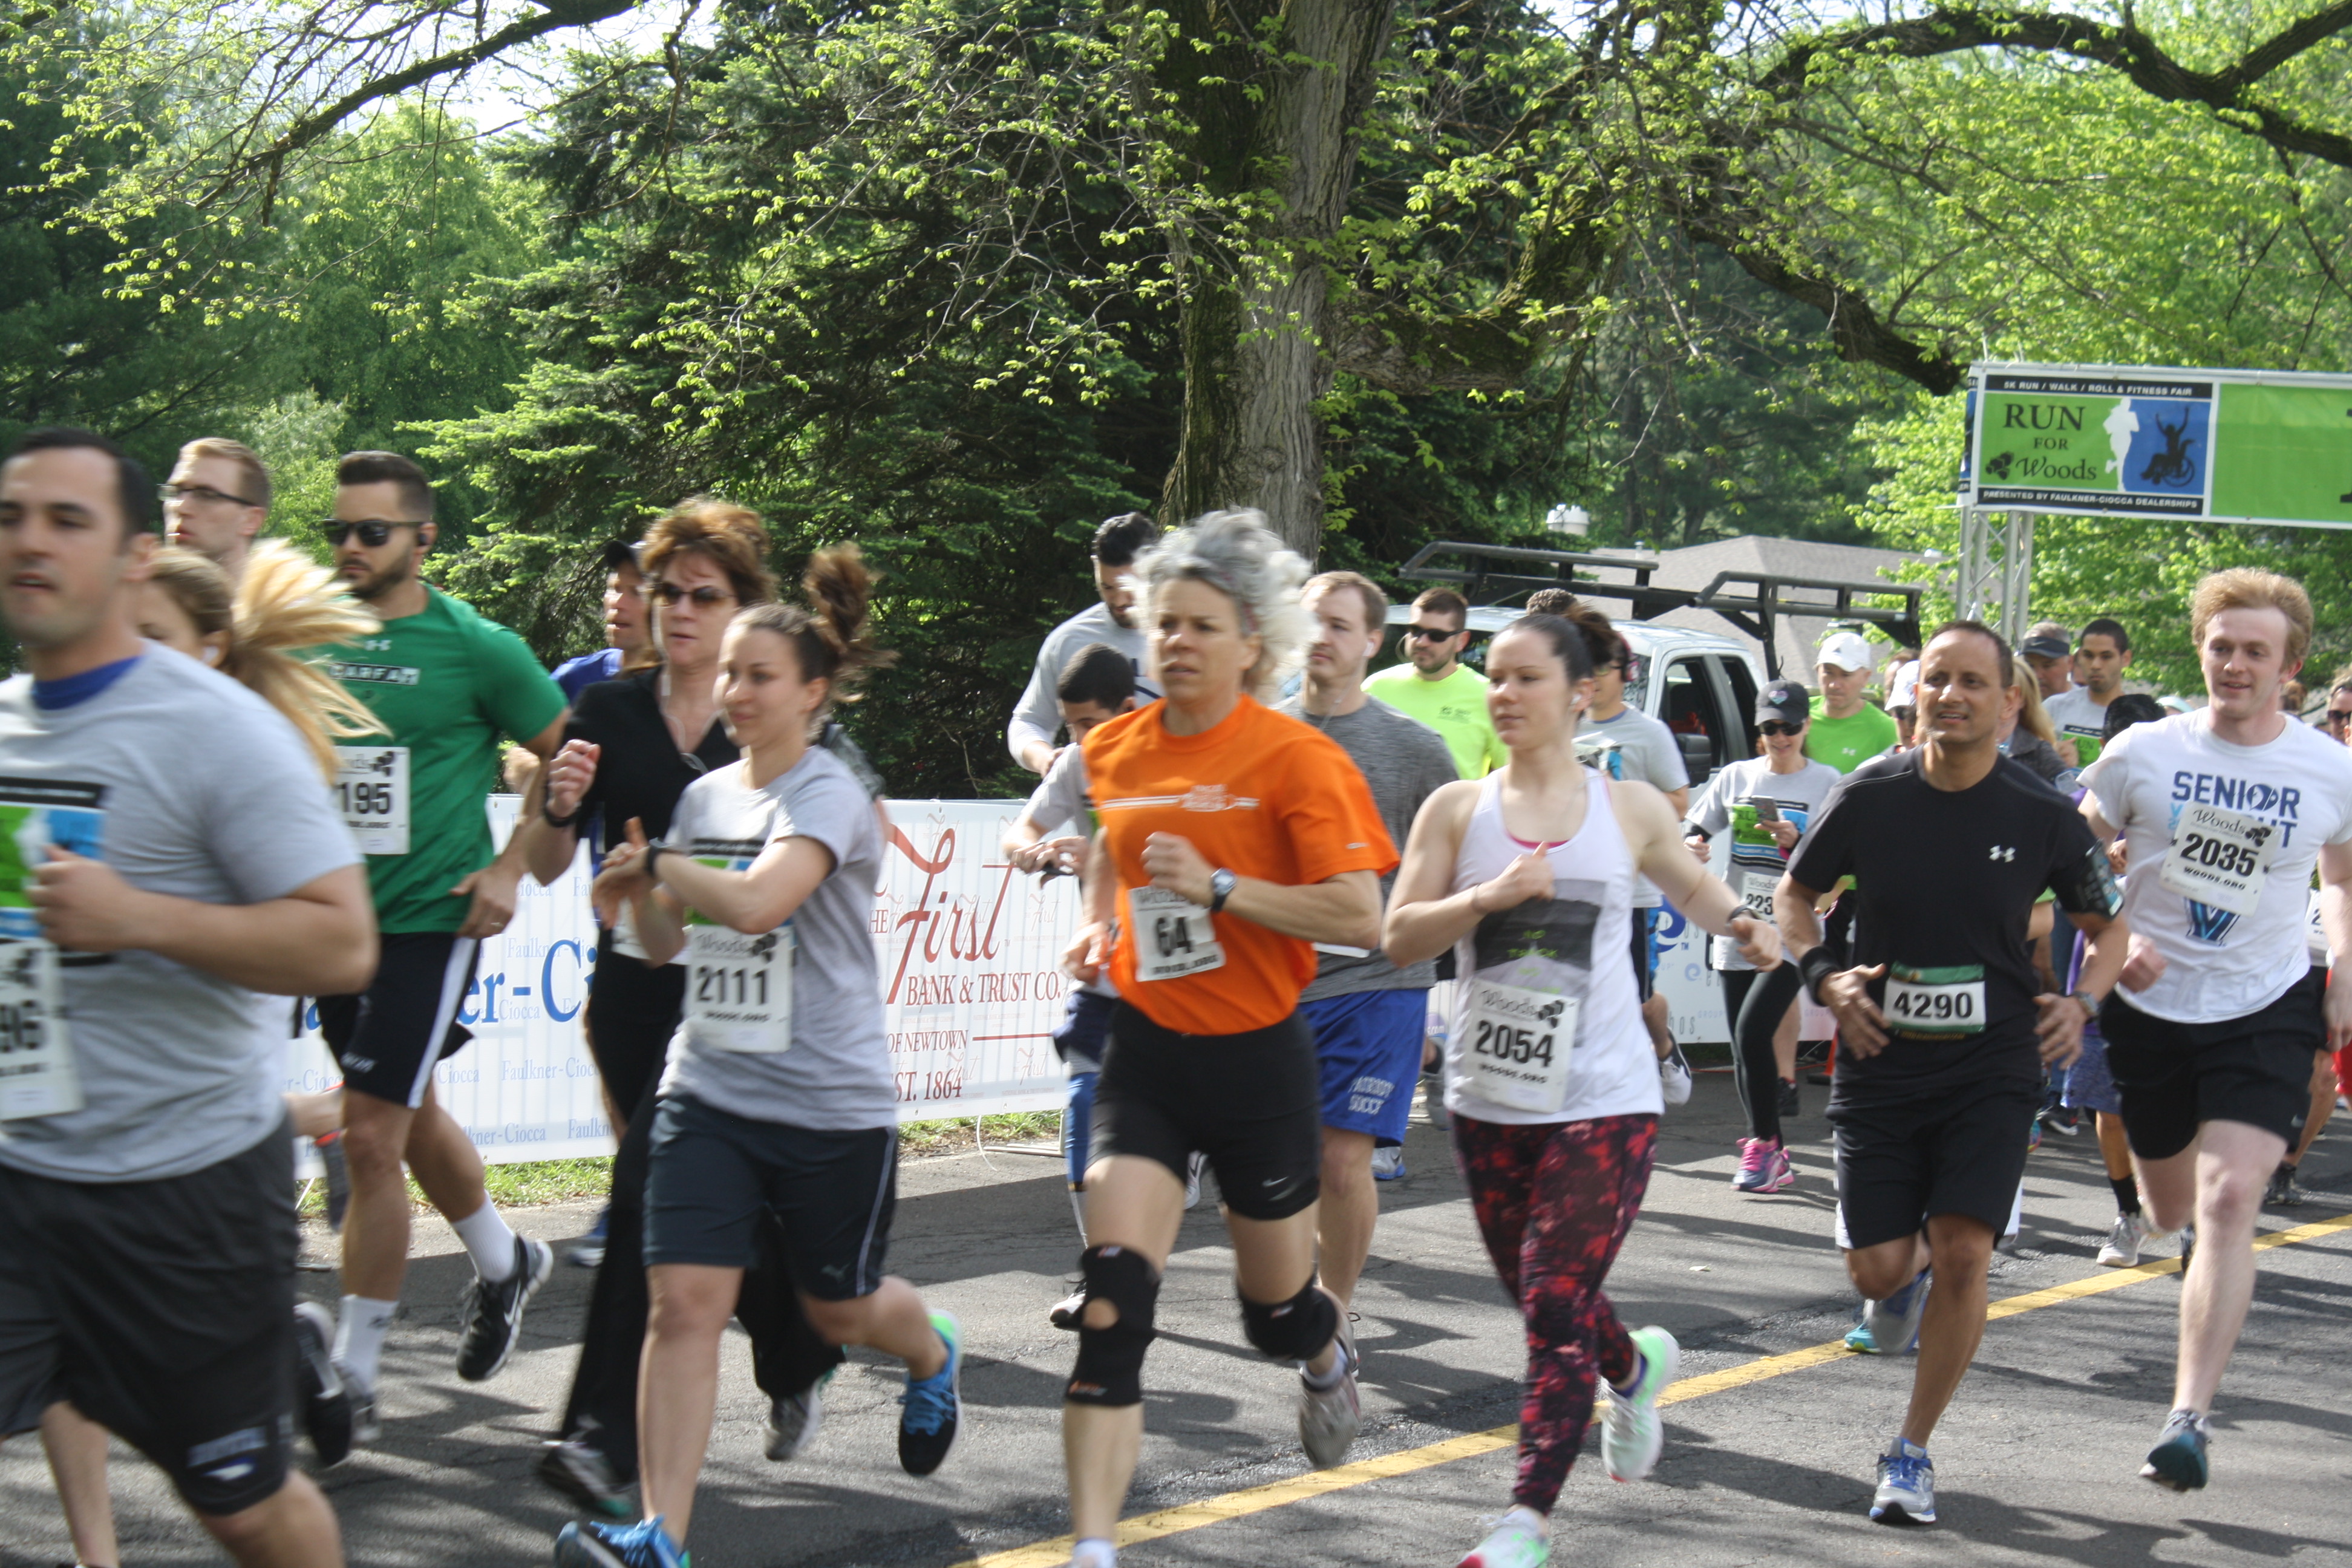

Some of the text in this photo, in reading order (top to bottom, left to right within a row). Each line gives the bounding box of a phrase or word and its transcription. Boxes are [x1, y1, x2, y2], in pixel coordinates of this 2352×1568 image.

[2019, 382, 2039, 390] RUN
[2049, 383, 2077, 391] WALK
[2088, 384, 2114, 393] ROLL
[2127, 385, 2169, 395] FITNESS
[2171, 387, 2193, 396] FAIR
[2003, 403, 2086, 431] RUN
[2034, 437, 2069, 451] FOR
[2016, 457, 2097, 481] Woods
[1983, 490, 2033, 500] PRESENTED
[2036, 492, 2048, 501] BY
[2135, 497, 2198, 509] DEALERSHIPS
[336, 782, 392, 814] 195
[2193, 809, 2246, 835] Woods
[2180, 832, 2259, 877] 2035
[2184, 866, 2246, 890] WOODS.ORG
[1746, 893, 1774, 915] 223
[867, 909, 889, 934] HE
[1155, 916, 1194, 958] 64
[697, 965, 769, 1005] 2111
[906, 971, 1061, 1006] BANK & TRUST CO.
[1893, 990, 1973, 1019] 4290
[903, 1030, 968, 1053] NEWTOWN
[1474, 1019, 1555, 1068] 2054
[891, 1067, 962, 1102] ST. 1864
